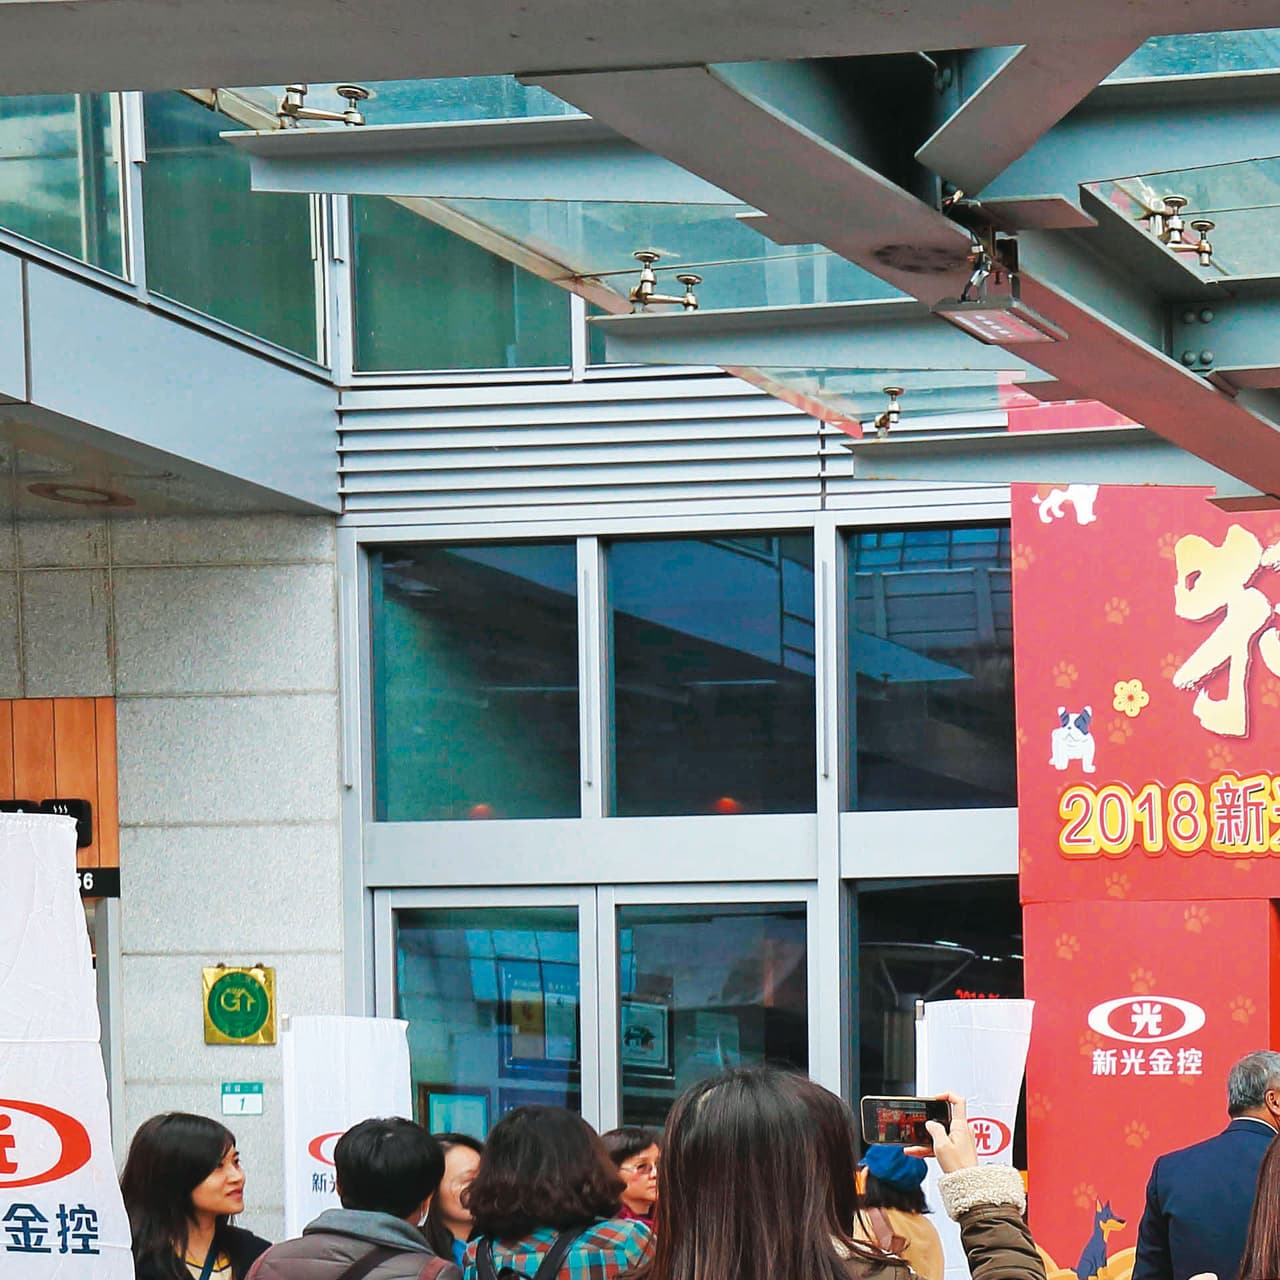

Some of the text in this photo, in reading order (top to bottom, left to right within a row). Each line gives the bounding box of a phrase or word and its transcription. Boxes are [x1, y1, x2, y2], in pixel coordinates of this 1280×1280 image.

[1131, 1002, 1162, 1036] 光
[1092, 1047, 1203, 1076] 新光金控
[2, 1202, 100, 1256] 金控
